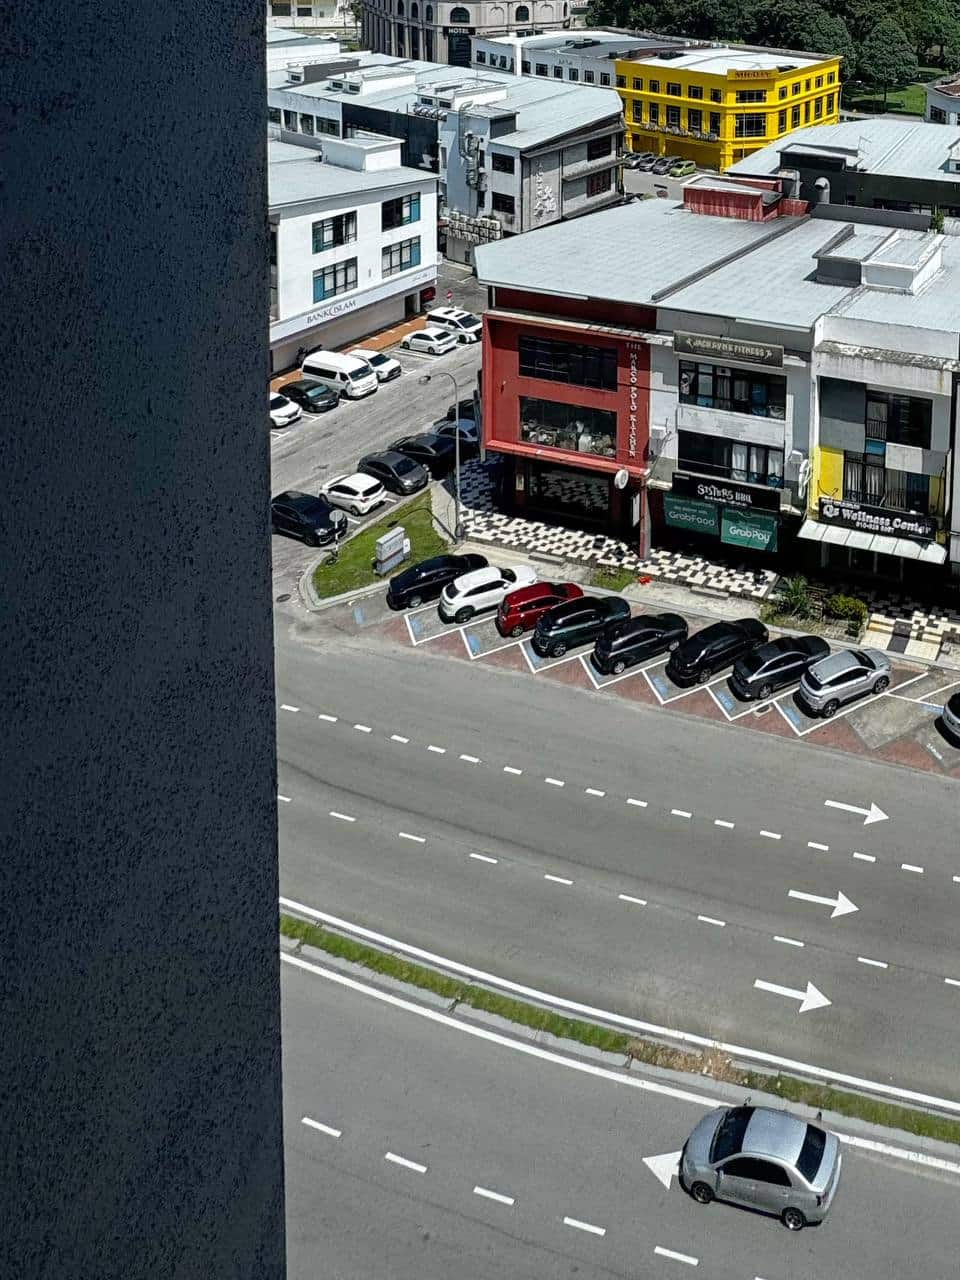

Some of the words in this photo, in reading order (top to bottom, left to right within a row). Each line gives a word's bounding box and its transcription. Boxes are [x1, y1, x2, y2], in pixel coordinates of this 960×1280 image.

[306, 310, 331, 324] BANK
[333, 300, 357, 314] ISLAM
[625, 342, 641, 350] THE
[629, 352, 638, 384] MARCO
[629, 386, 638, 411] POLO
[629, 413, 637, 457] KITCHEN
[697, 484, 733, 501] SISTERS
[735, 491, 753, 504] BBQ
[668, 510, 716, 527] GrabFood
[841, 508, 891, 527] Wellness
[892, 517, 932, 535] Center
[729, 525, 771, 545] GrabPay
